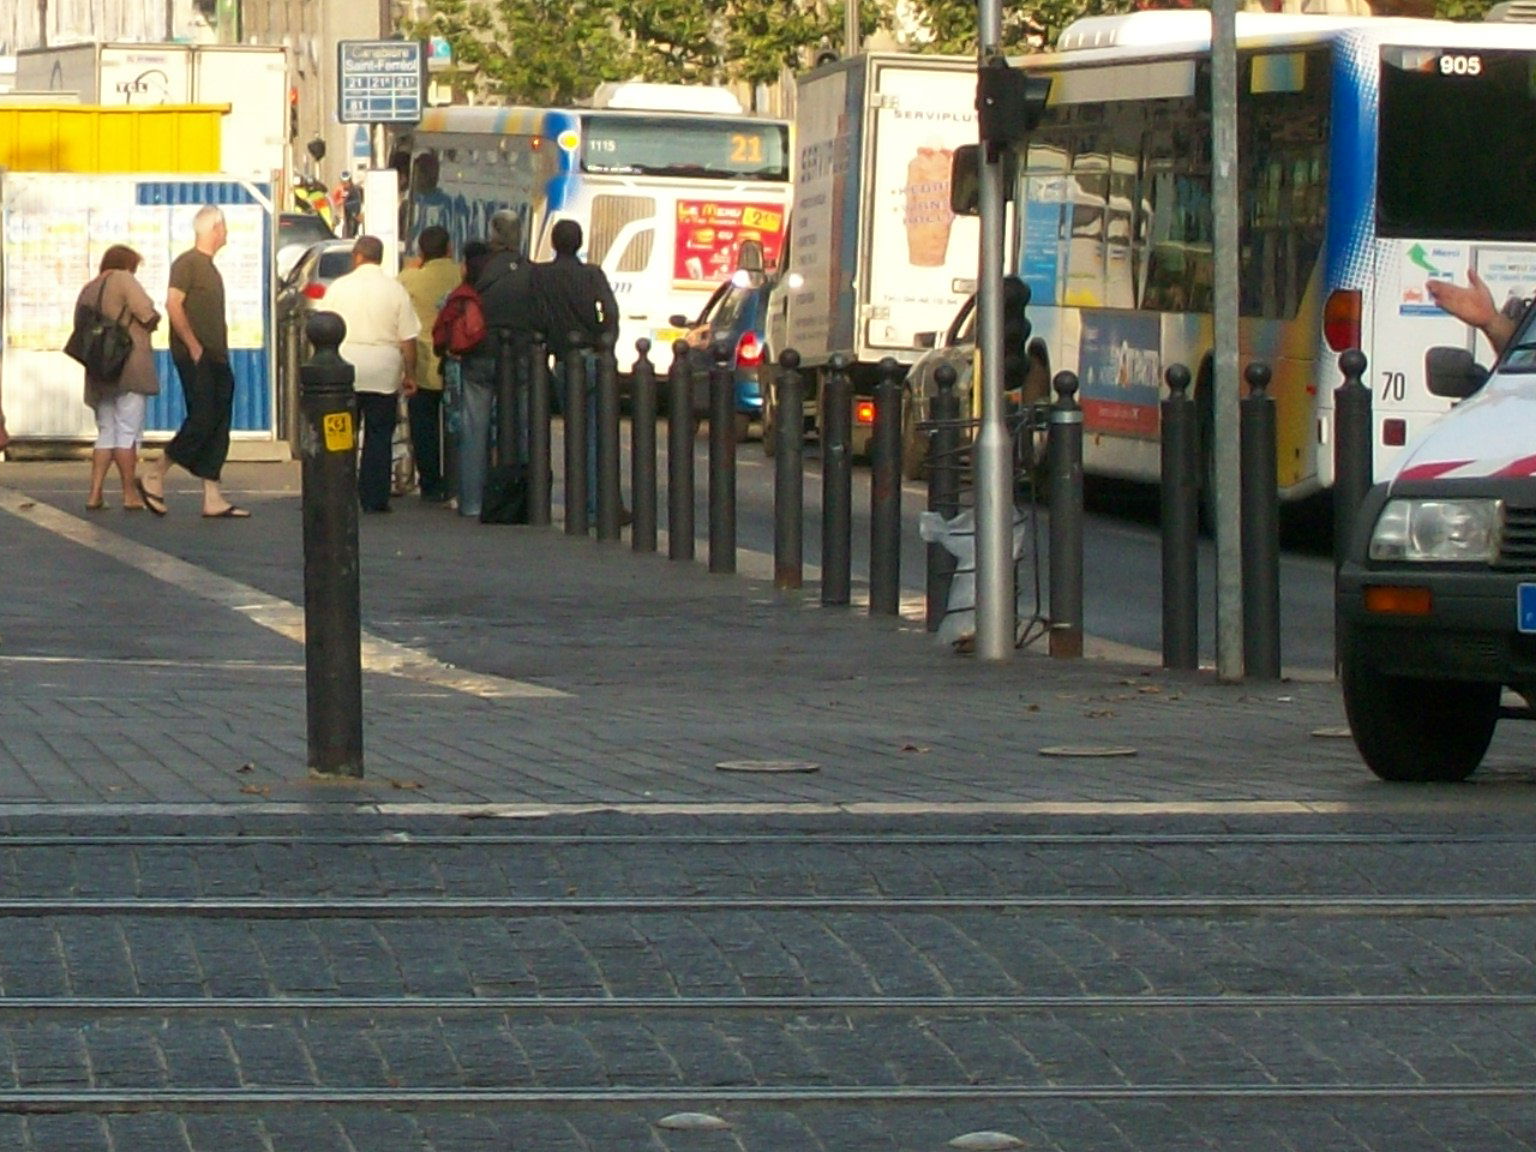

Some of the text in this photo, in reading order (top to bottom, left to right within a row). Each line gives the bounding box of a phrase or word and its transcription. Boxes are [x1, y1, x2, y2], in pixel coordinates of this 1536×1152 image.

[1440, 55, 1481, 75] 905
[350, 78, 362, 88] 21
[894, 109, 972, 123] SERVIPLU
[730, 134, 762, 162] 21
[1382, 372, 1405, 401] 70
